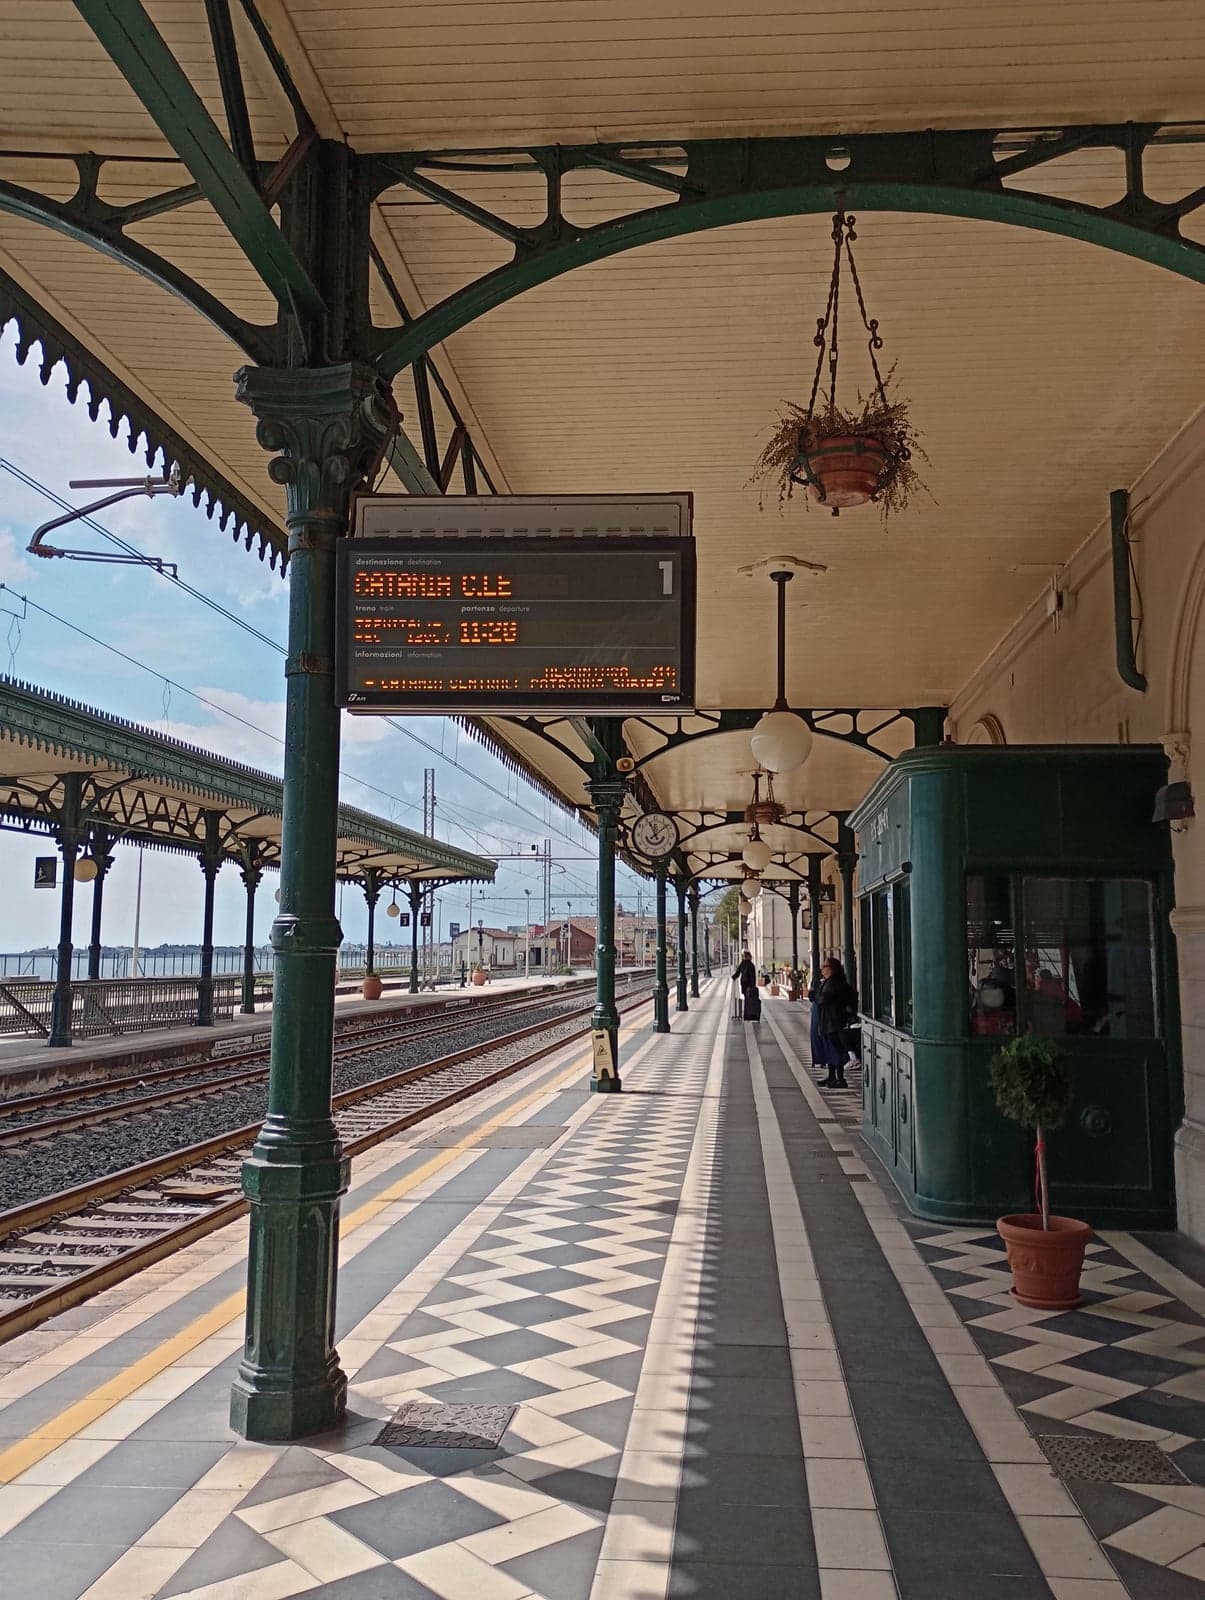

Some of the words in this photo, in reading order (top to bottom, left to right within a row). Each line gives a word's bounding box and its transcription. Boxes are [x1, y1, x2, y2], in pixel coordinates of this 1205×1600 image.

[355, 557, 404, 566] destinazione
[407, 558, 442, 566] destination
[658, 560, 673, 595] 1
[355, 573, 451, 597] CATANIA
[461, 605, 495, 613] partenza
[498, 605, 530, 613] departure
[354, 650, 403, 658] informazioni
